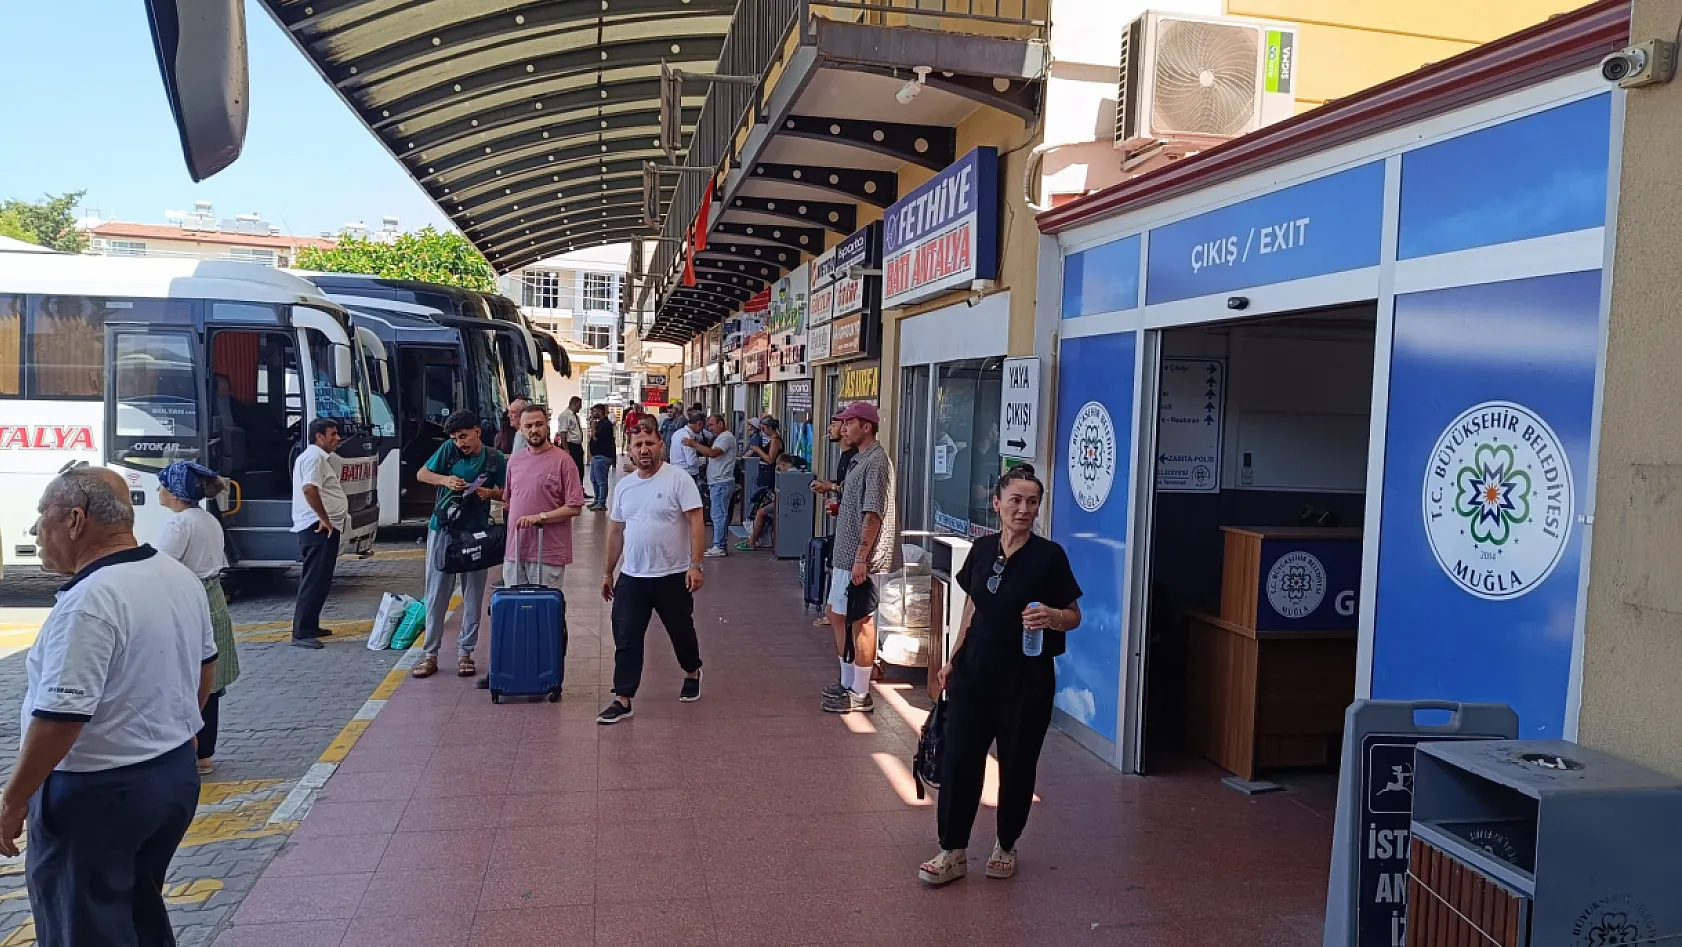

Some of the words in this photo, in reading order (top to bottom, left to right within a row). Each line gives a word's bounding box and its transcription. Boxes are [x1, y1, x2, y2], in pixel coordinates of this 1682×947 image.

[885, 249, 911, 299] BATI
[911, 222, 971, 290] ANTALYA
[1191, 241, 1237, 274] ÇIKIŞ
[1260, 217, 1311, 253] EXIT
[1008, 364, 1030, 389] YAYA
[1006, 402, 1031, 432] ÇIKIŞI
[134, 442, 179, 451] OTOKAR
[1435, 409, 1519, 479] BÜYÜKŞEHİR
[1521, 424, 1564, 540] BELEDİYESİ
[1431, 486, 1443, 522] T.C.
[1453, 559, 1522, 592] MUĞLA
